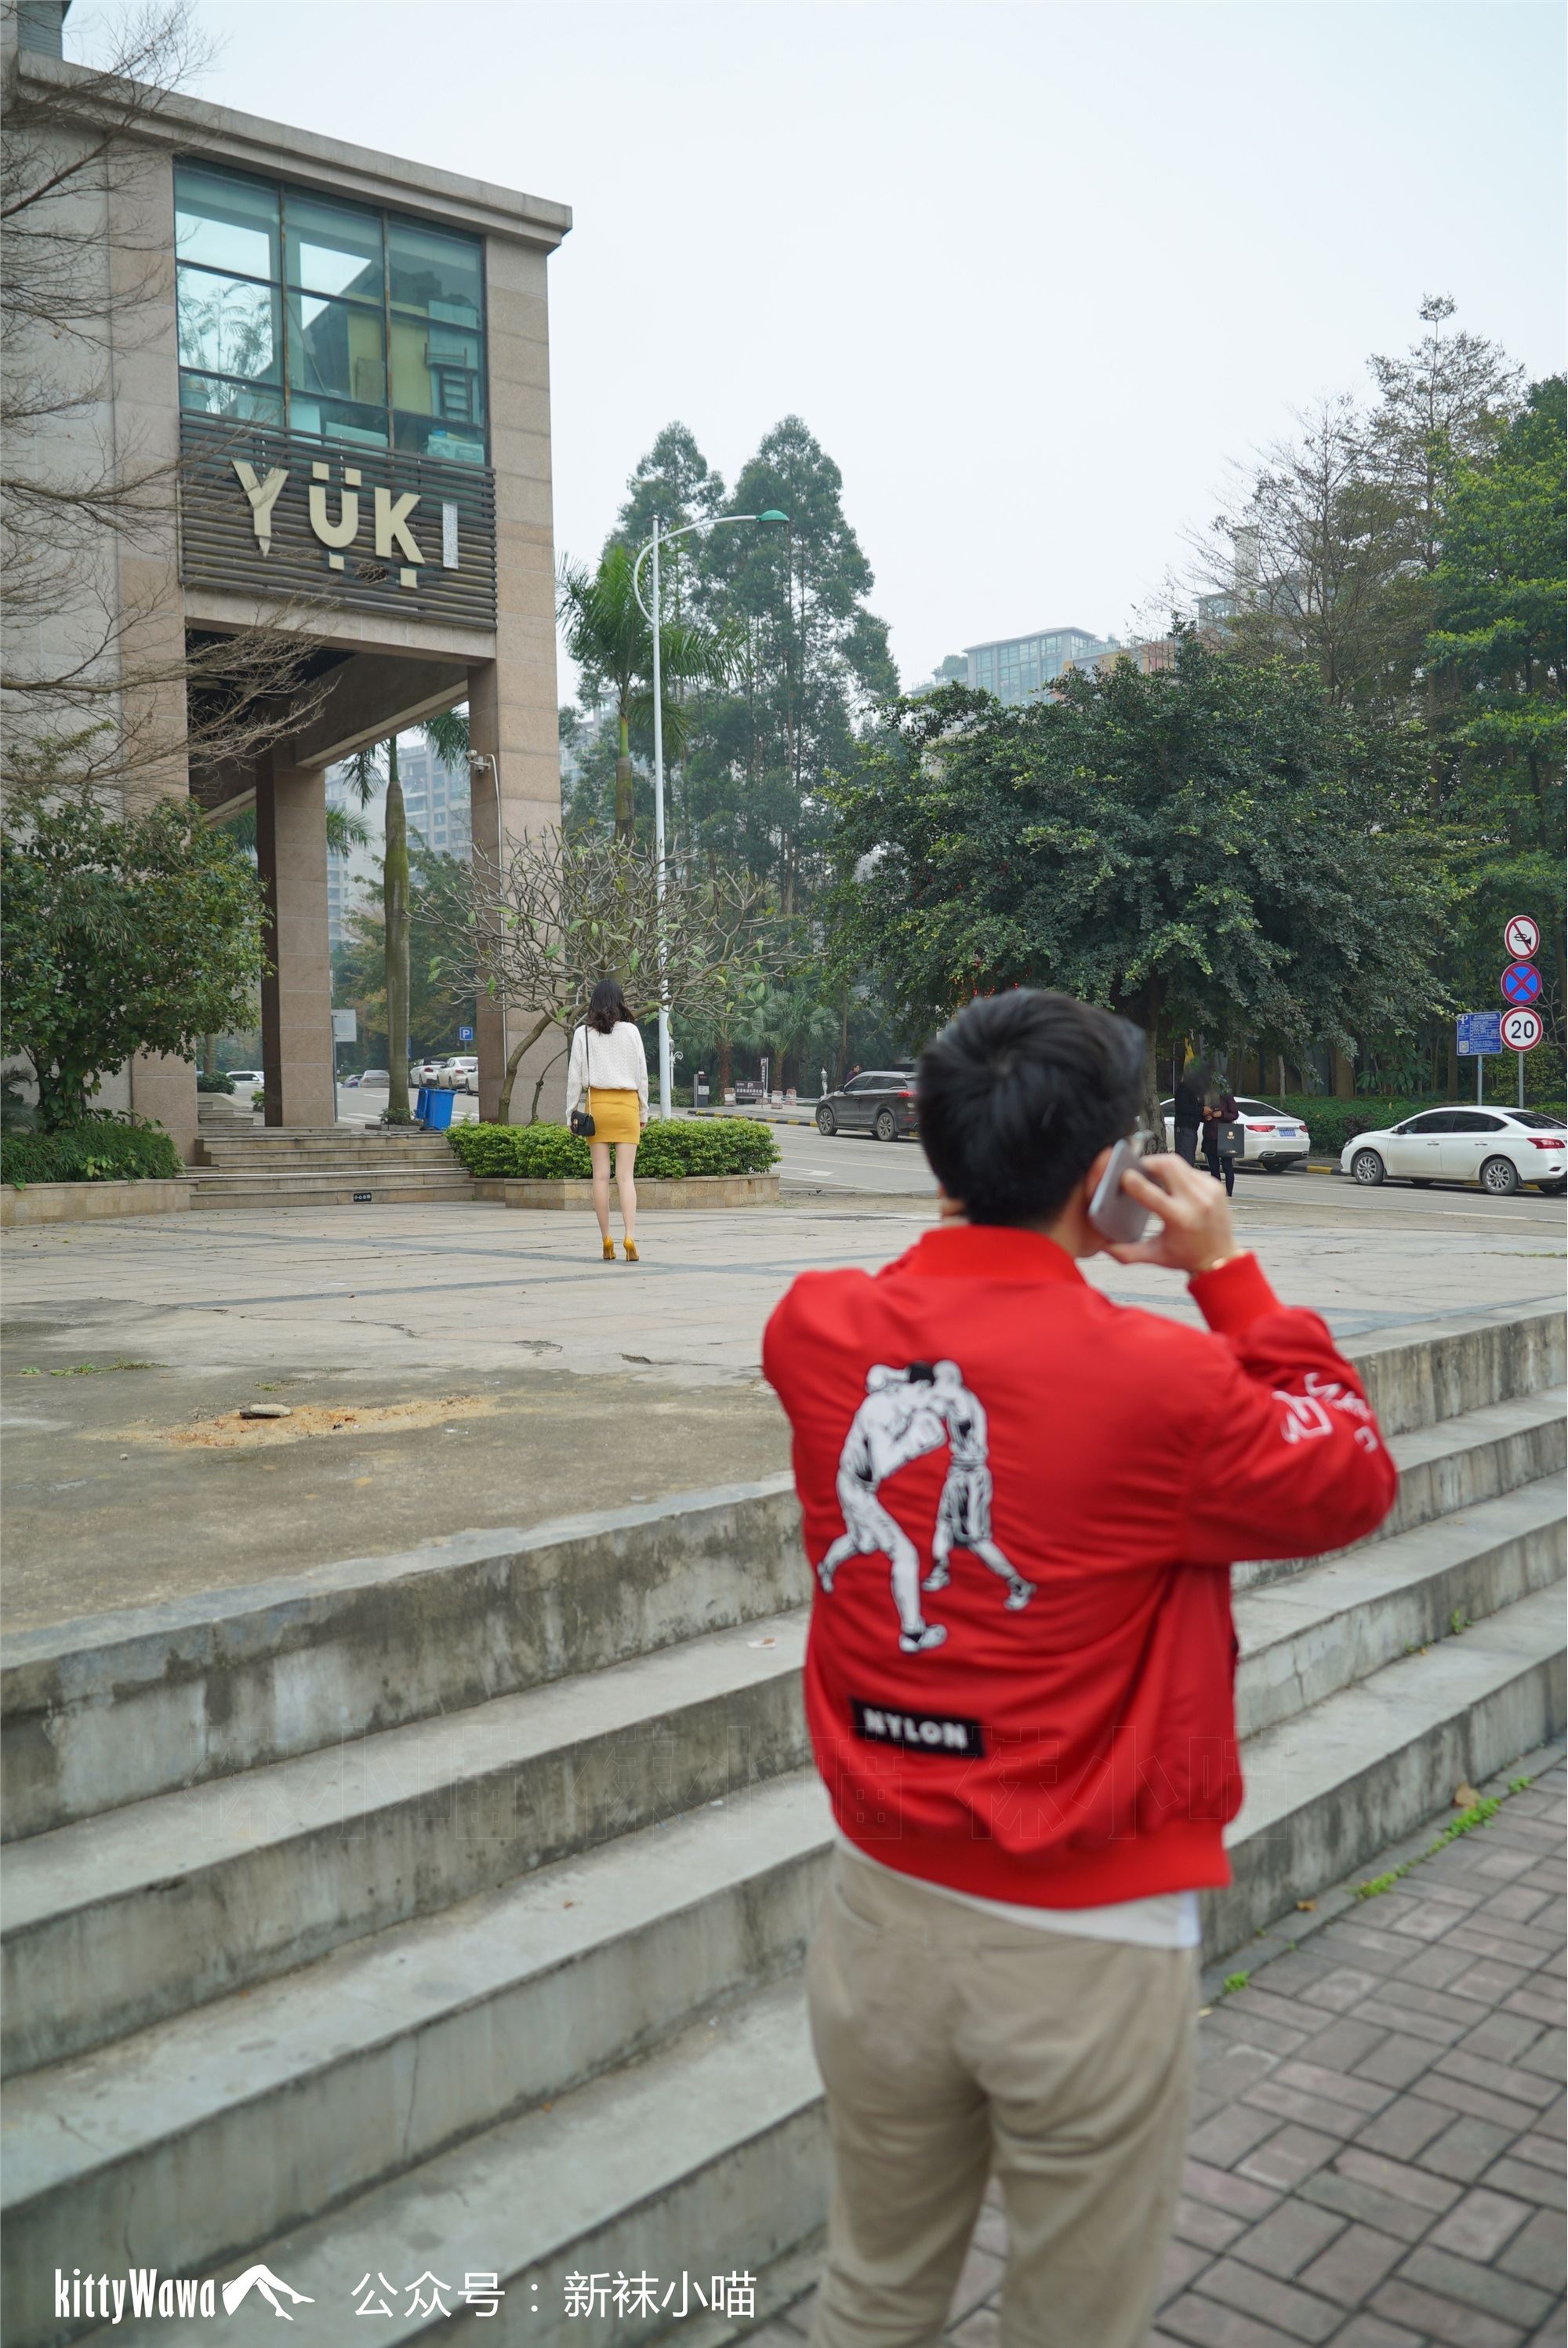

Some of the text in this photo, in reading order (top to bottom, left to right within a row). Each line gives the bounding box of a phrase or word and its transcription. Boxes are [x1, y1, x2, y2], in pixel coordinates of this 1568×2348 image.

[463, 1029, 470, 1038] P
[1511, 1020, 1534, 1039] 20
[863, 1707, 968, 1750] NYLON
